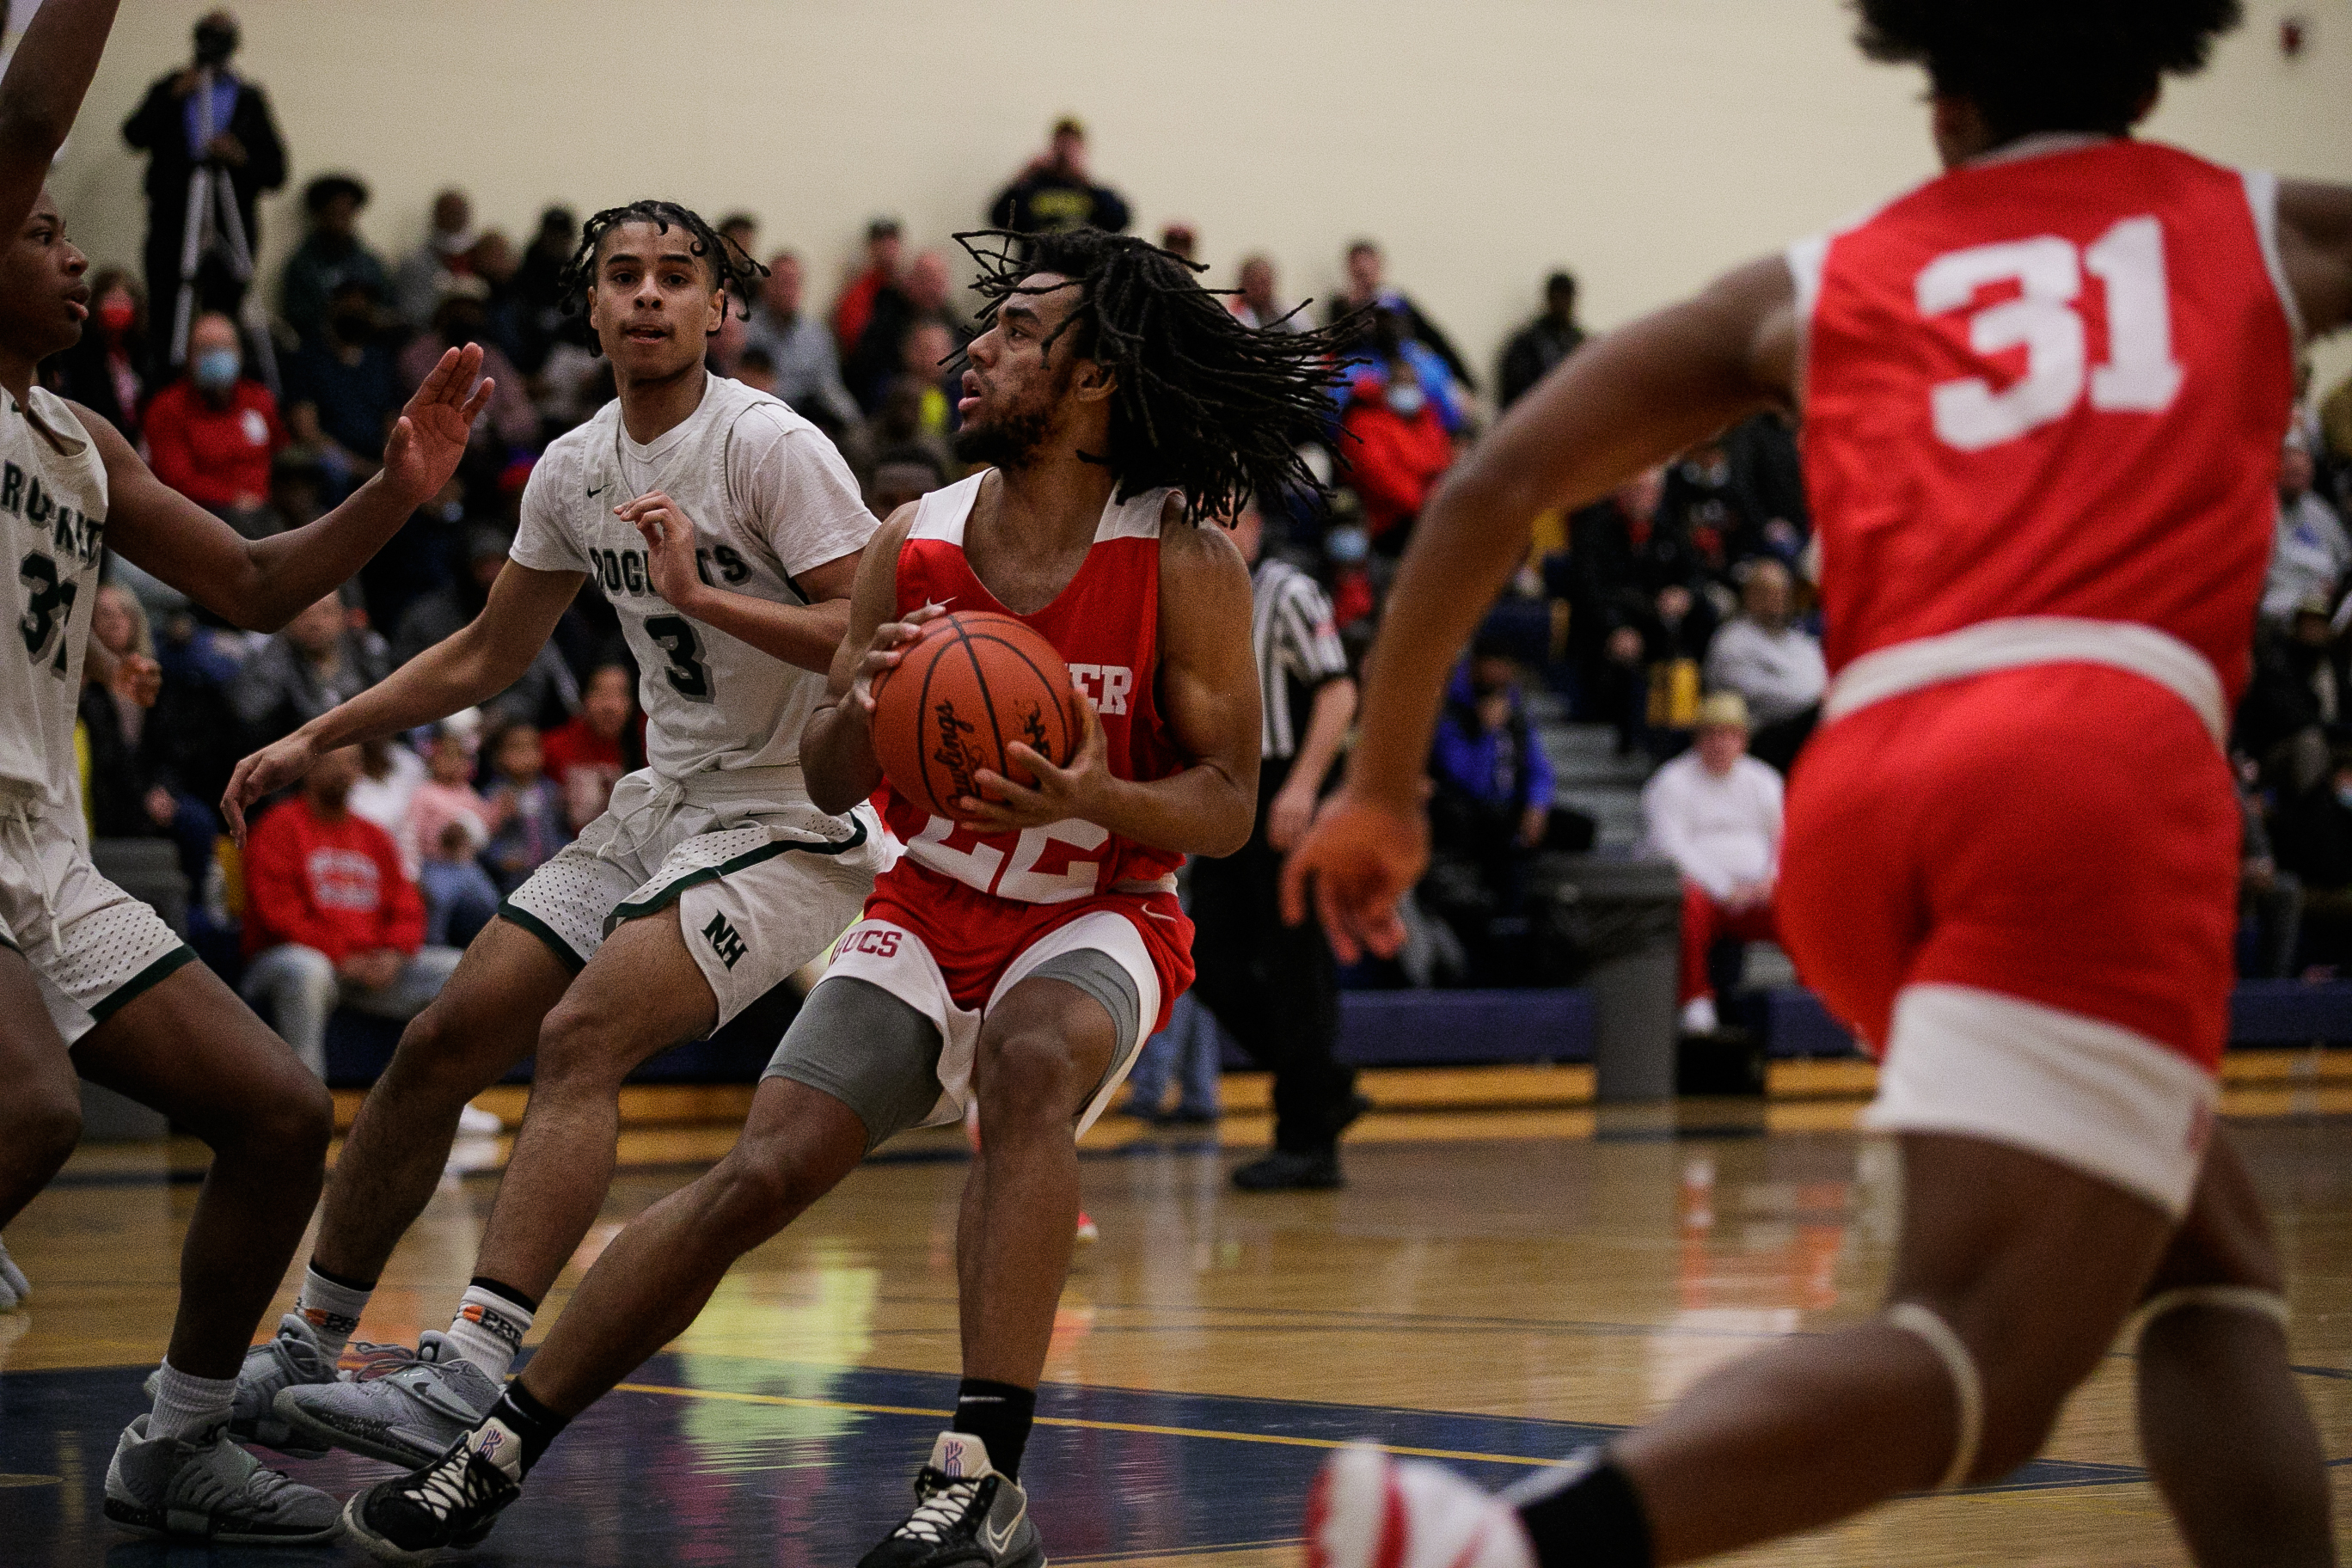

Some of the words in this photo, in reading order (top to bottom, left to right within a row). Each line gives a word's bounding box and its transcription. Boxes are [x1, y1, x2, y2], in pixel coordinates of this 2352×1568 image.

[1915, 215, 2189, 450] 31
[588, 545, 753, 597] ROCTS
[644, 614, 716, 703] 3
[1065, 663, 1133, 715] ER
[701, 909, 749, 972] NH
